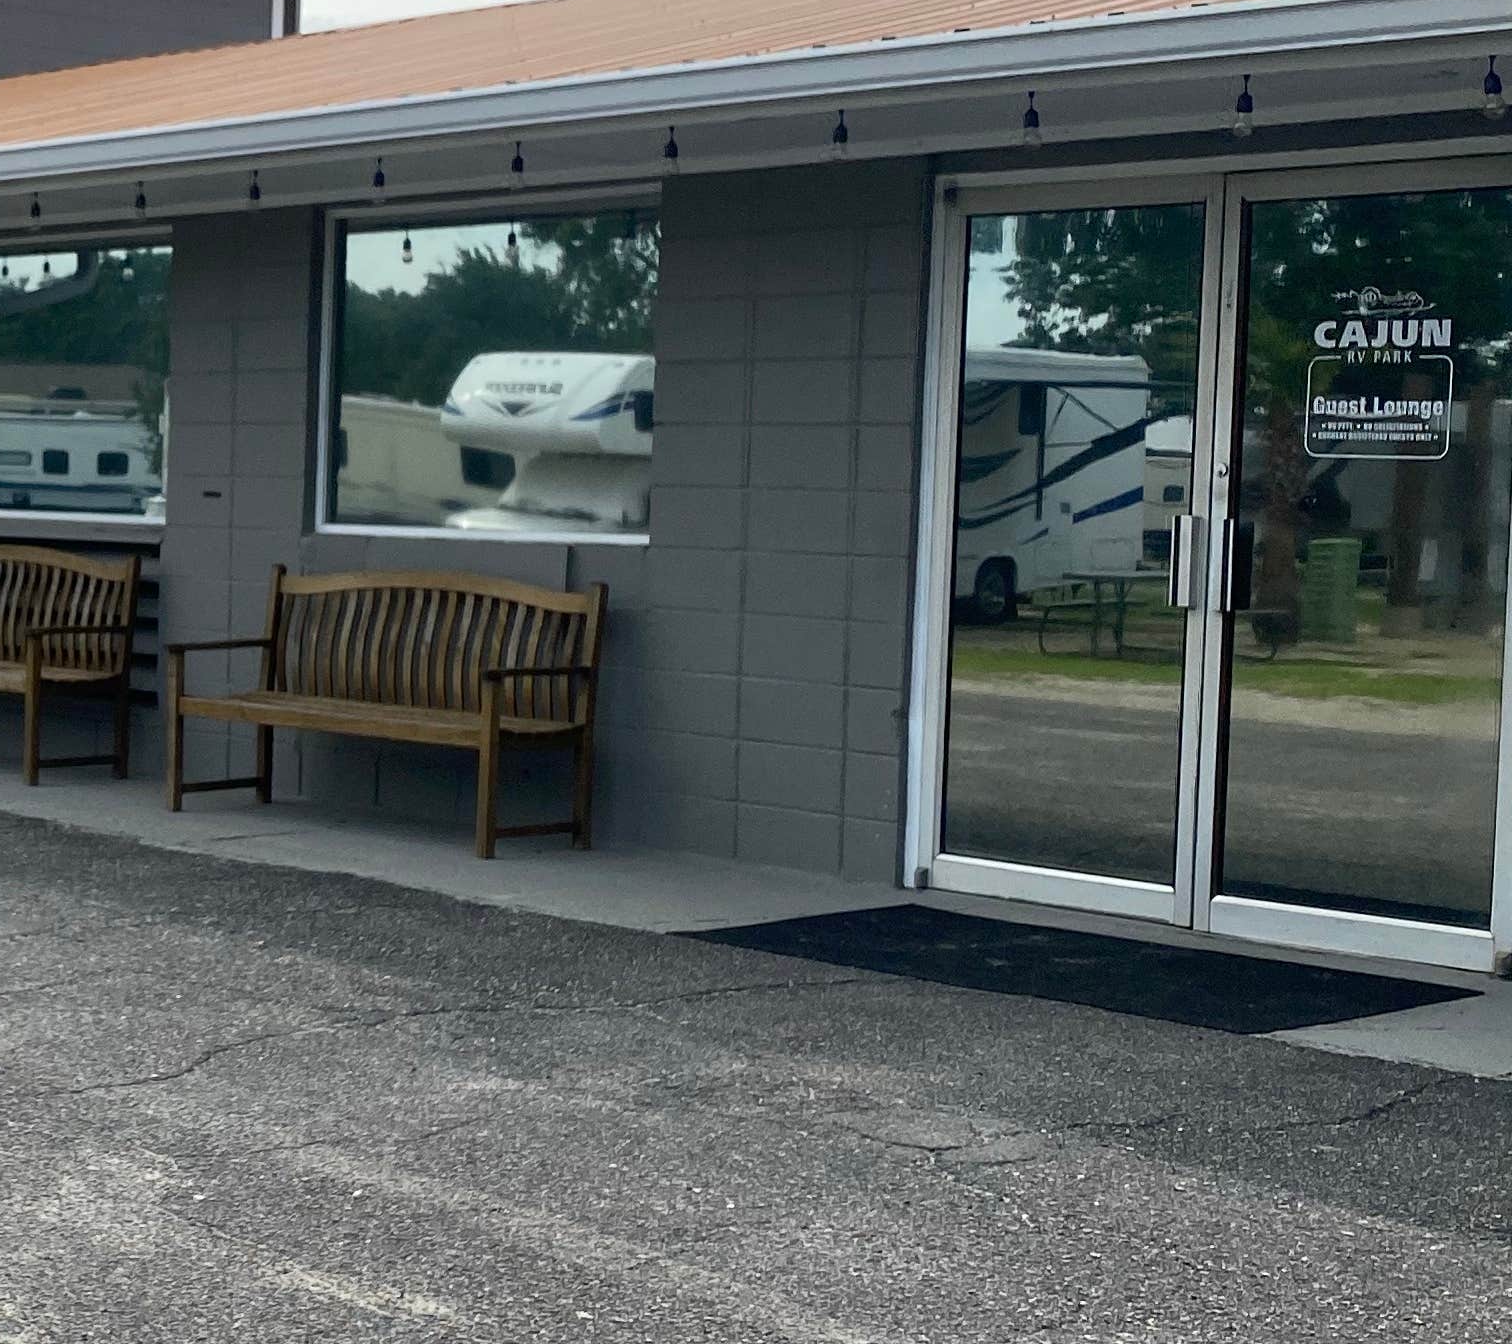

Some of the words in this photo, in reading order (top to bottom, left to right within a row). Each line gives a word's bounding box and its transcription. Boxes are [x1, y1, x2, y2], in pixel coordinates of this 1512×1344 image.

[1313, 319, 1452, 348] CAJUN
[1347, 350, 1366, 364] RV
[1373, 350, 1413, 364] PARK
[1313, 395, 1367, 416] Guest
[1374, 396, 1444, 419] Lounge
